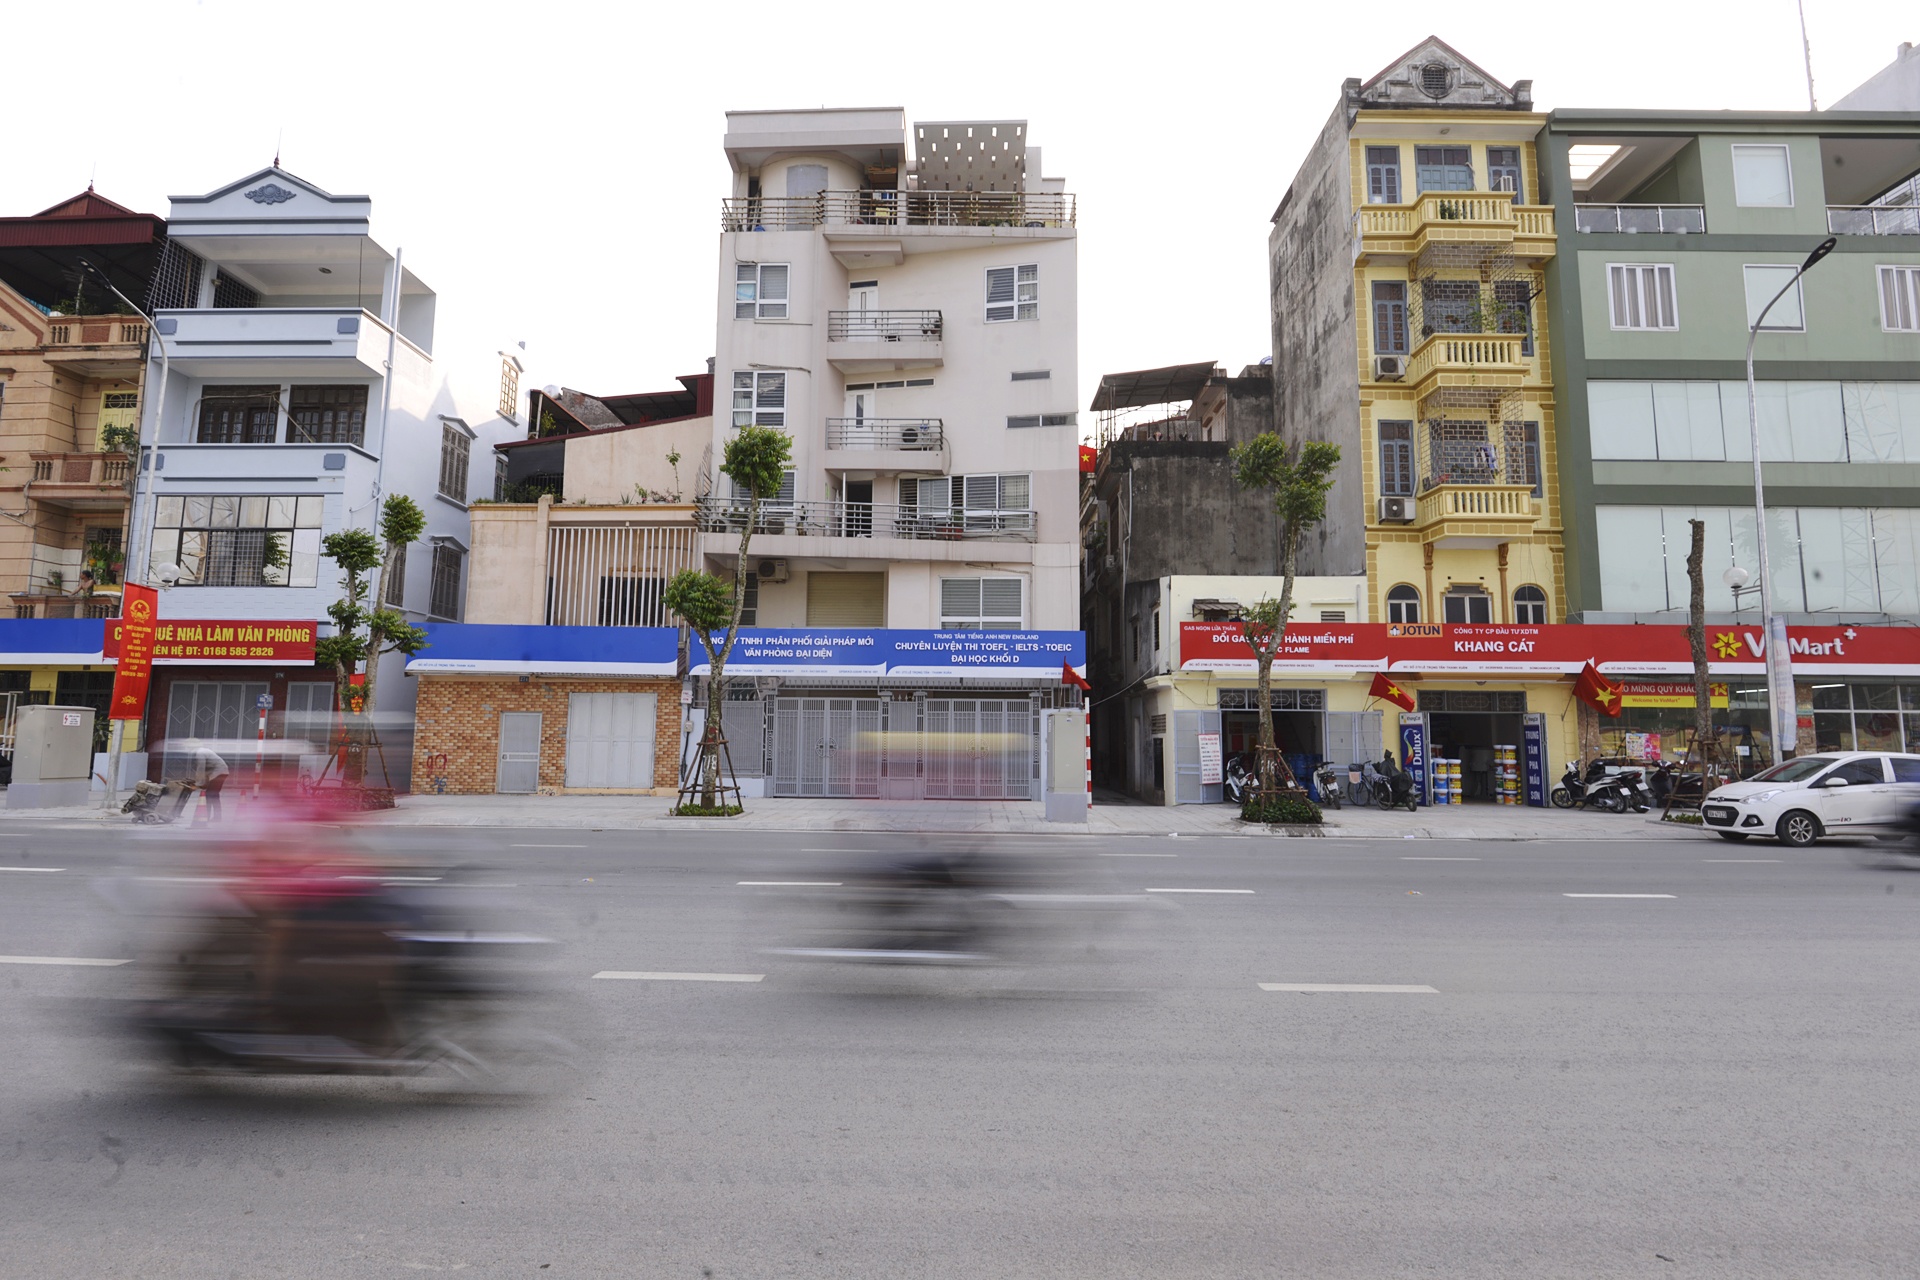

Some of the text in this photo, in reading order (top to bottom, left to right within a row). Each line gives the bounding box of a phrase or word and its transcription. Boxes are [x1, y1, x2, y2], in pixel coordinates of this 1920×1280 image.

[177, 624, 202, 641] NHÀ
[206, 624, 234, 642] LÀM
[237, 624, 263, 642] VĂN
[266, 624, 310, 642] PHÒNG
[968, 632, 984, 640] TIẾNG
[1402, 626, 1440, 636] JOTUN
[1454, 626, 1473, 634] CÔNG
[1496, 626, 1510, 634] ĐẦU
[740, 637, 763, 645] TNHH
[766, 636, 790, 646] PHÂN
[792, 634, 812, 646] PHỐI
[814, 635, 832, 646] GIẢI
[832, 636, 856, 646] PHÁP
[858, 636, 874, 646] MỚI
[1212, 631, 1230, 643] ĐỔI
[1284, 633, 1312, 644] HÀNH
[1314, 632, 1336, 644] MIỄN
[1338, 633, 1354, 644] PHÍ
[171, 644, 184, 656] HỆ
[186, 646, 200, 656] ĐT:
[203, 646, 227, 656] 0168
[229, 647, 248, 656] 585
[250, 647, 274, 656] 2826
[895, 640, 931, 650] CHUYÊN
[932, 640, 962, 652] LUYỆN
[964, 643, 978, 651] THI
[980, 643, 1009, 651] TOEFL
[1046, 644, 1072, 652] TOEIC
[1454, 638, 1536, 652] KHANG CÁT
[744, 647, 833, 660] VĂN PHÒNG ĐẠI DIỆN
[951, 655, 967, 664] ĐẠI
[968, 655, 988, 664] HỌC
[990, 652, 1011, 662] KHỐI
[1631, 684, 1656, 693] MỪNG
[1525, 731, 1539, 740] TRUNG
[1412, 733, 1422, 766] Dulux
[1528, 761, 1538, 770] PHA
